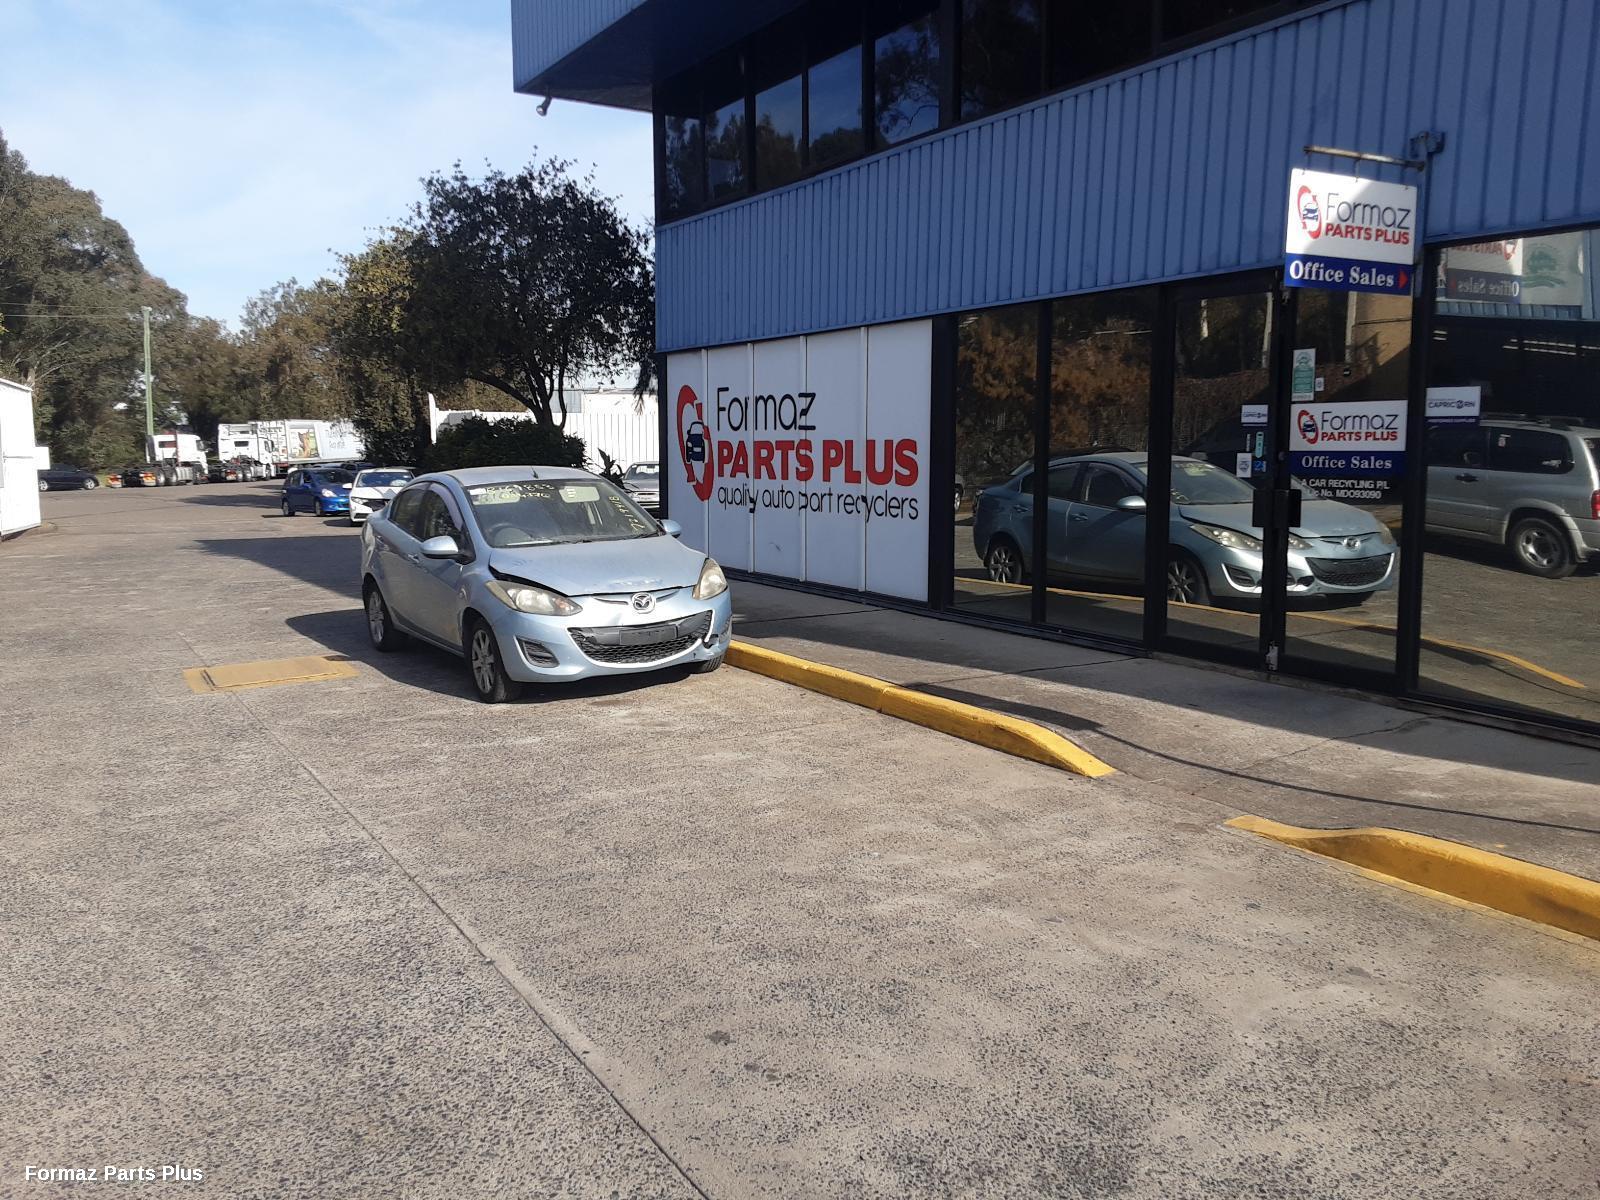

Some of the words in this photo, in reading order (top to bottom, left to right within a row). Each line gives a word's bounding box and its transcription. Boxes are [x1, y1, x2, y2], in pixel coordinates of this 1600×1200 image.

[1326, 192, 1411, 230] Formaz
[1325, 222, 1372, 242] PARTS
[1375, 227, 1410, 245] PLUS
[1289, 260, 1344, 283] Office
[1349, 266, 1394, 287] Sales
[717, 387, 816, 432] Formaz
[1321, 411, 1399, 430] Formaz
[1321, 431, 1362, 441] PARTS
[1364, 431, 1398, 441] PLUS
[717, 440, 814, 482] PARTS
[822, 439, 919, 487] PLUS
[1301, 455, 1346, 468] Office
[1350, 456, 1392, 469] Sales
[1309, 479, 1327, 488] CAR
[1328, 479, 1375, 489] RECYCLING
[717, 483, 759, 514] qualiy
[762, 484, 795, 509] auto
[837, 489, 919, 523] recyclers
